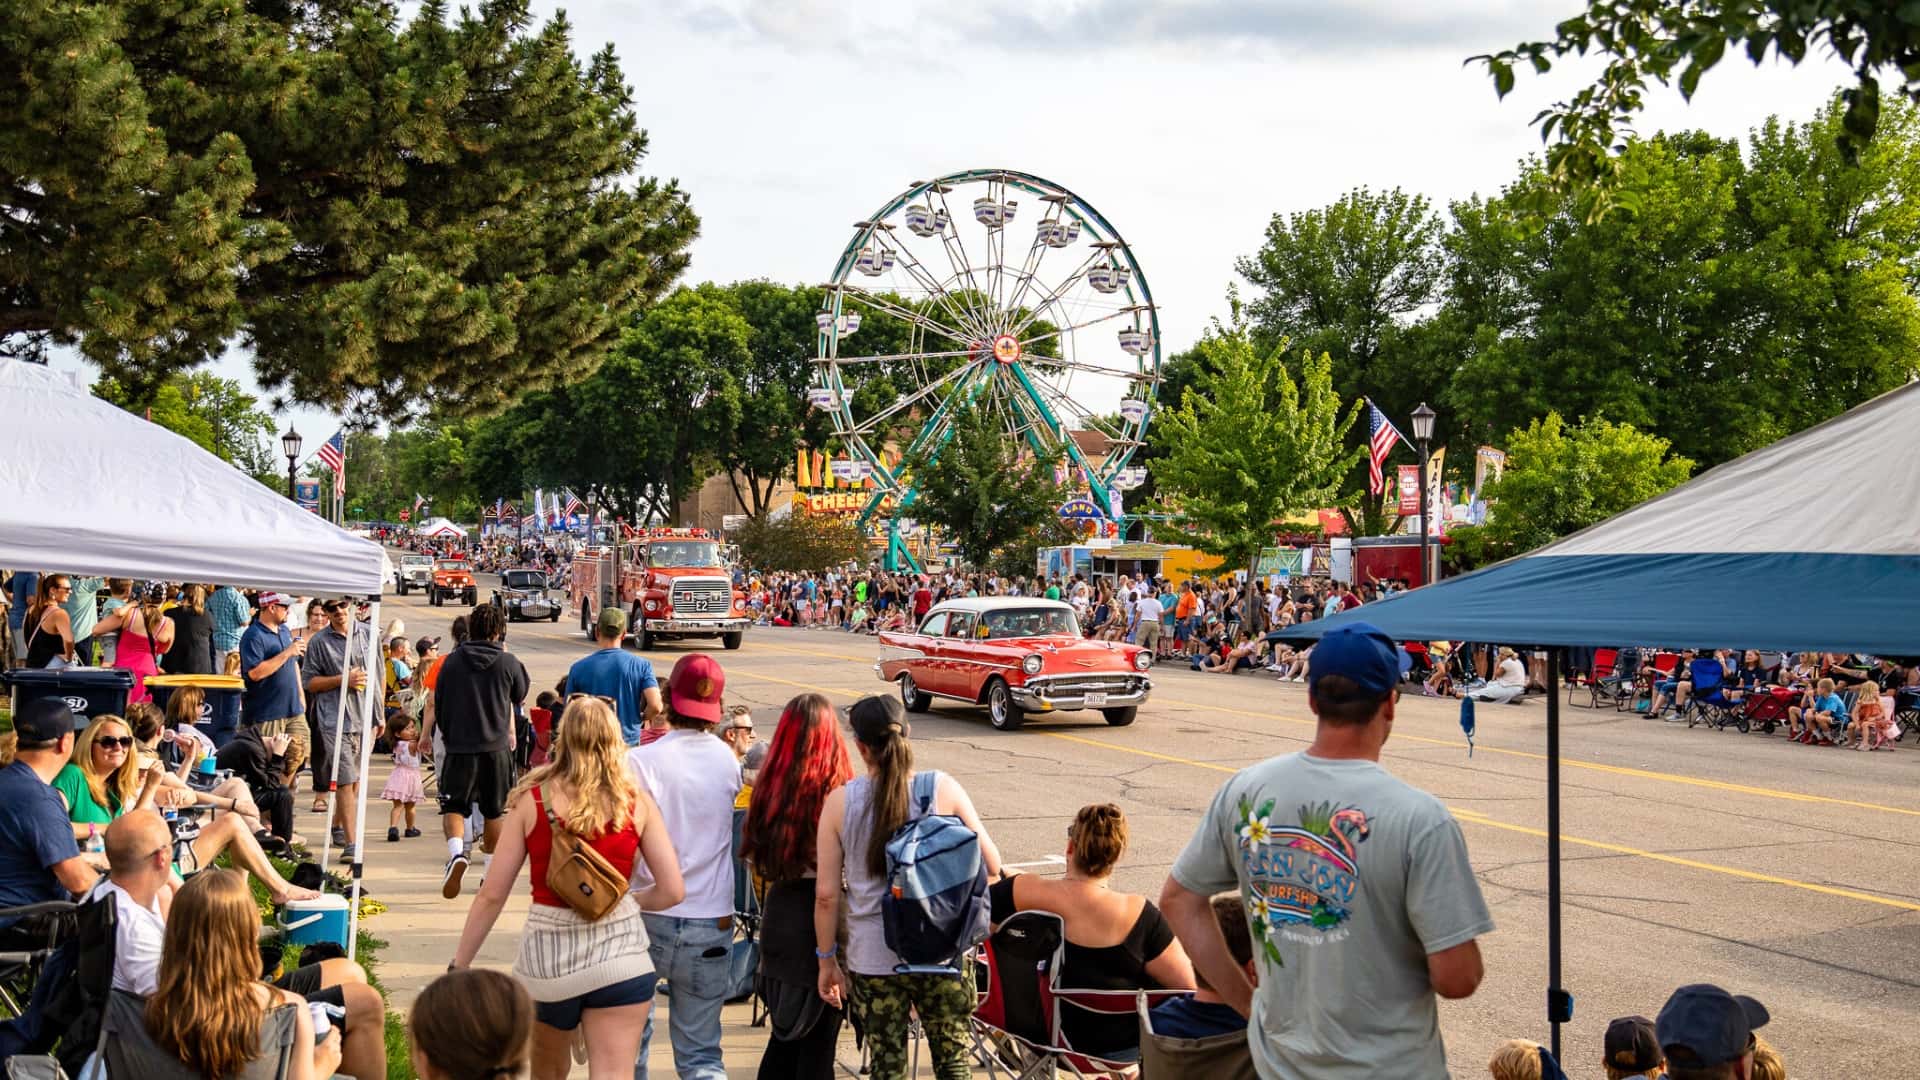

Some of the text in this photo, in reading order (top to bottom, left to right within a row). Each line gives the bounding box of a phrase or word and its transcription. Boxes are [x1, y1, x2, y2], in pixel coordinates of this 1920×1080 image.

[811, 493, 876, 511] CHEES
[1065, 503, 1093, 514] LAND
[696, 600, 708, 612] E2
[1267, 884, 1293, 900] URF
